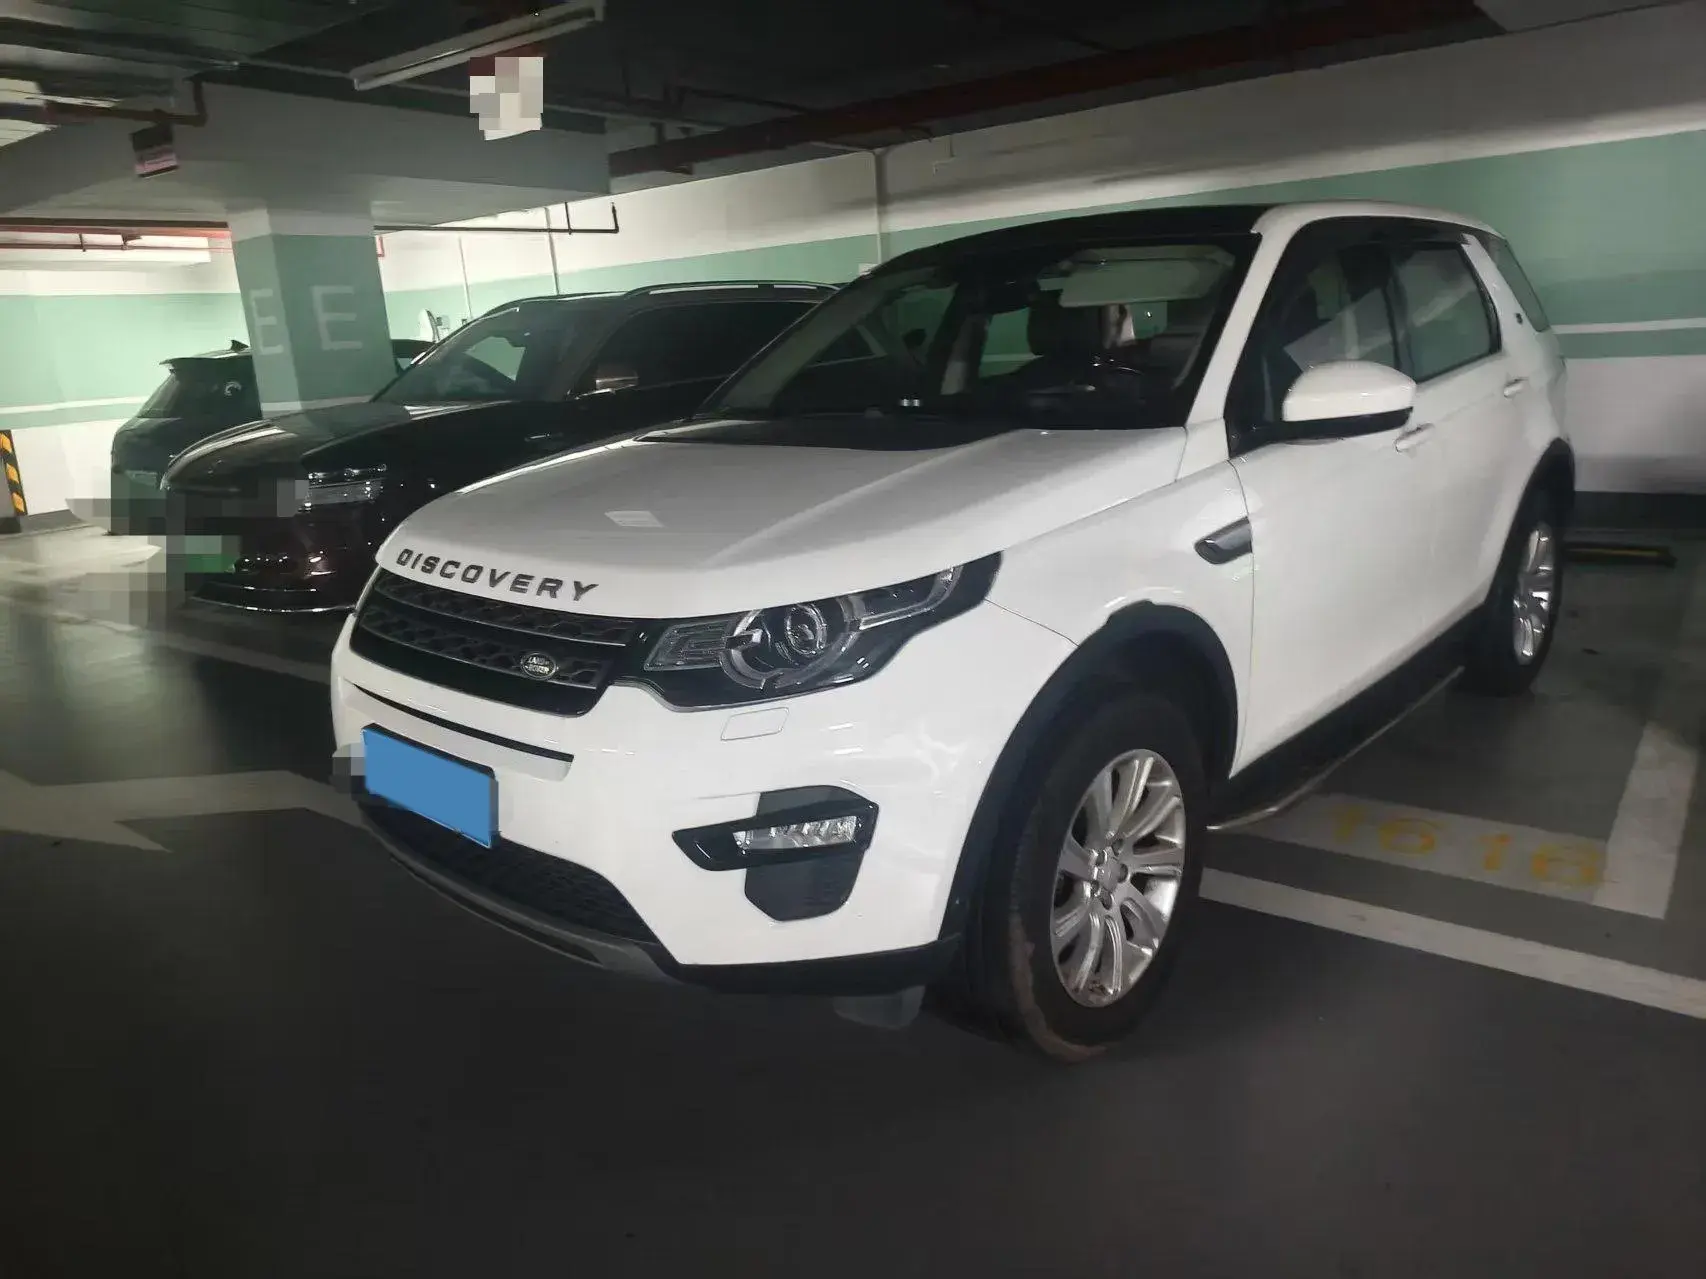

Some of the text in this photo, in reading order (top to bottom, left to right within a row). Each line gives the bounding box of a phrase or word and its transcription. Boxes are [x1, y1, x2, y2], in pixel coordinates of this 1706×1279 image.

[251, 288, 284, 355] E
[311, 285, 363, 350] E
[396, 548, 599, 601] DISCOVERY
